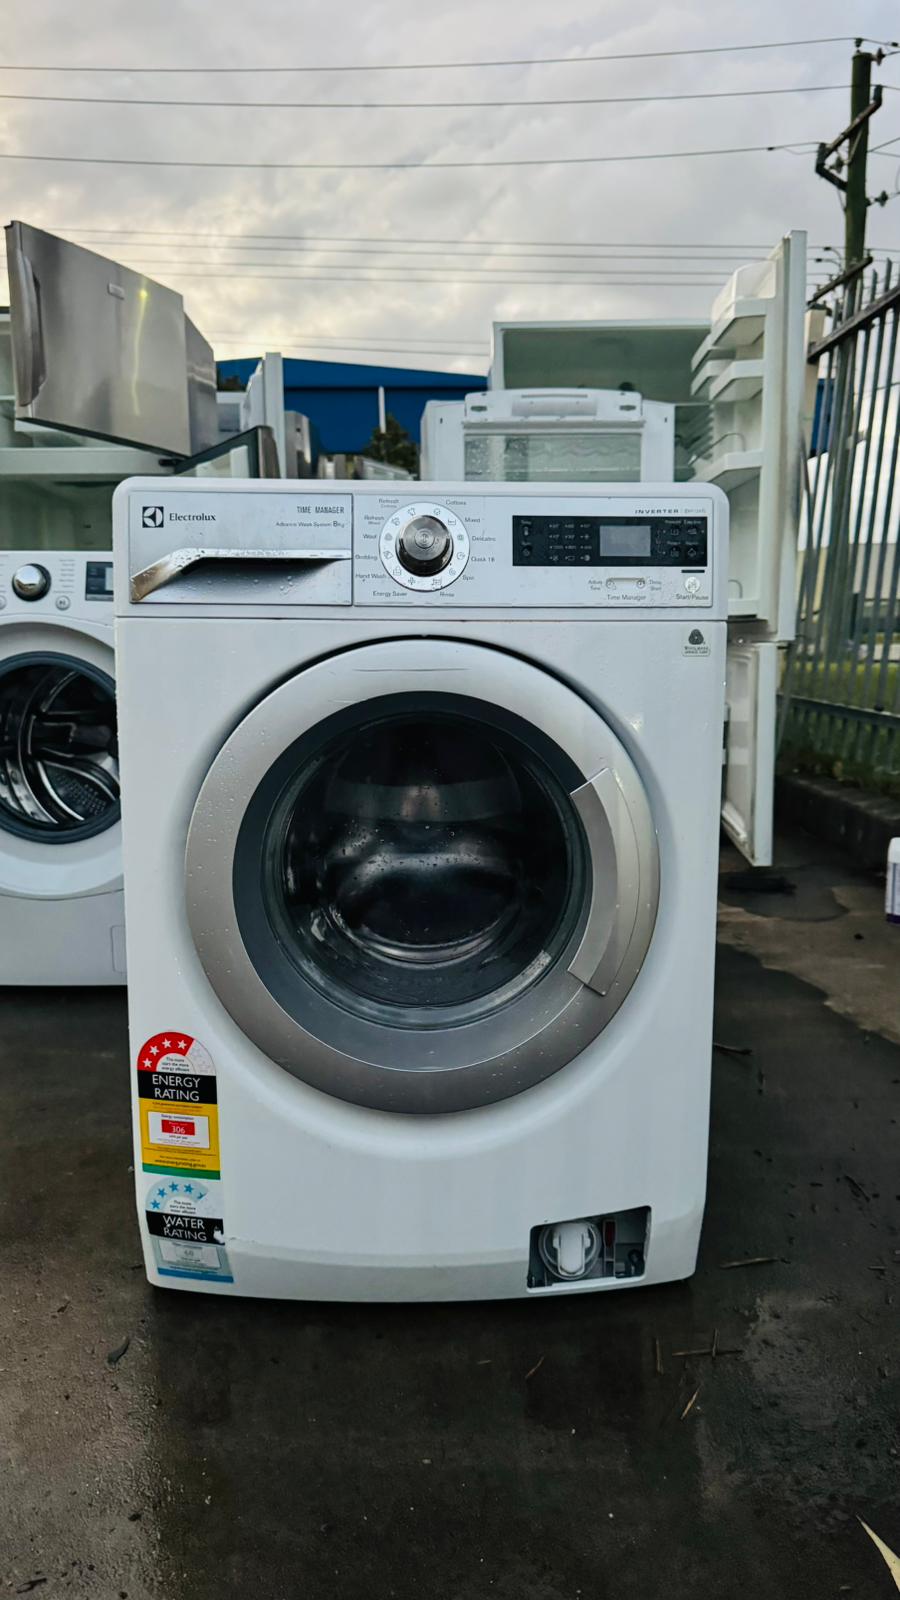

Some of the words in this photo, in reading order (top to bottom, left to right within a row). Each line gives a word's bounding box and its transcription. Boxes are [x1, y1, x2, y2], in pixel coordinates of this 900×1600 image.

[169, 512, 216, 521] Electrolux
[152, 1074, 200, 1088] ENERGY
[154, 1088, 199, 1101] RATING
[172, 1126, 185, 1134] 306
[163, 1215, 204, 1229] WATER
[164, 1227, 207, 1241] RATING
